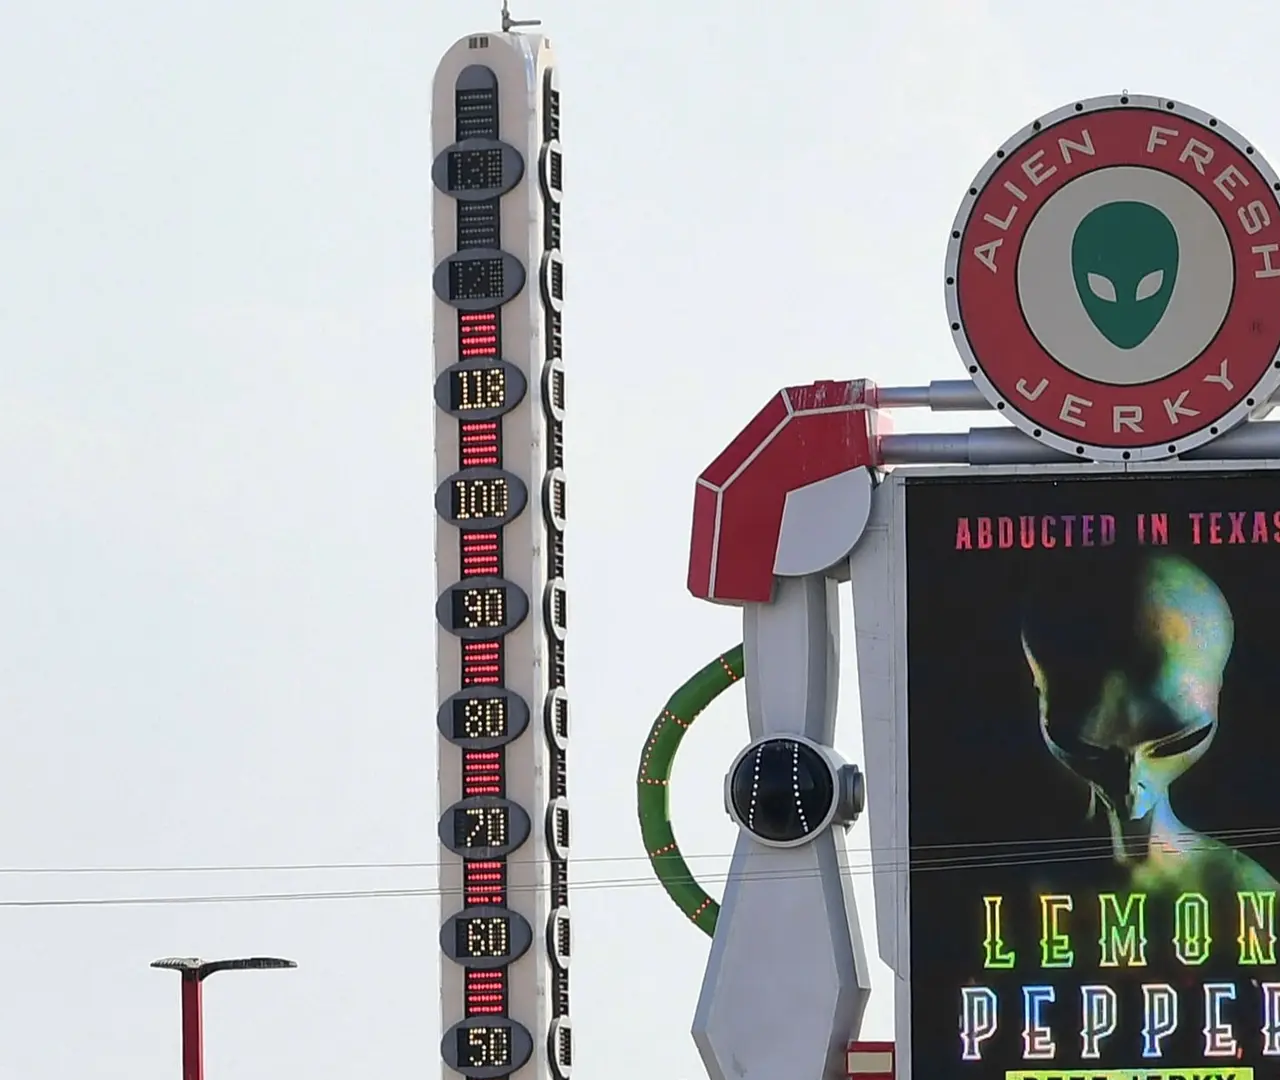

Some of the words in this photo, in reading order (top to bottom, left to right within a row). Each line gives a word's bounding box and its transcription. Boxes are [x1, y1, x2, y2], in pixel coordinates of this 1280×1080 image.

[973, 129, 1096, 273] ALIEN
[1016, 358, 1234, 434] JERKY
[456, 479, 508, 519] 100
[955, 516, 1116, 550] ABDUCTED
[1136, 513, 1169, 545] IN
[464, 589, 503, 628] 90
[465, 698, 504, 737] 80
[466, 808, 505, 847] 70
[468, 918, 507, 956] 60
[982, 891, 1278, 968] LEMON
[468, 1027, 508, 1067] 50
